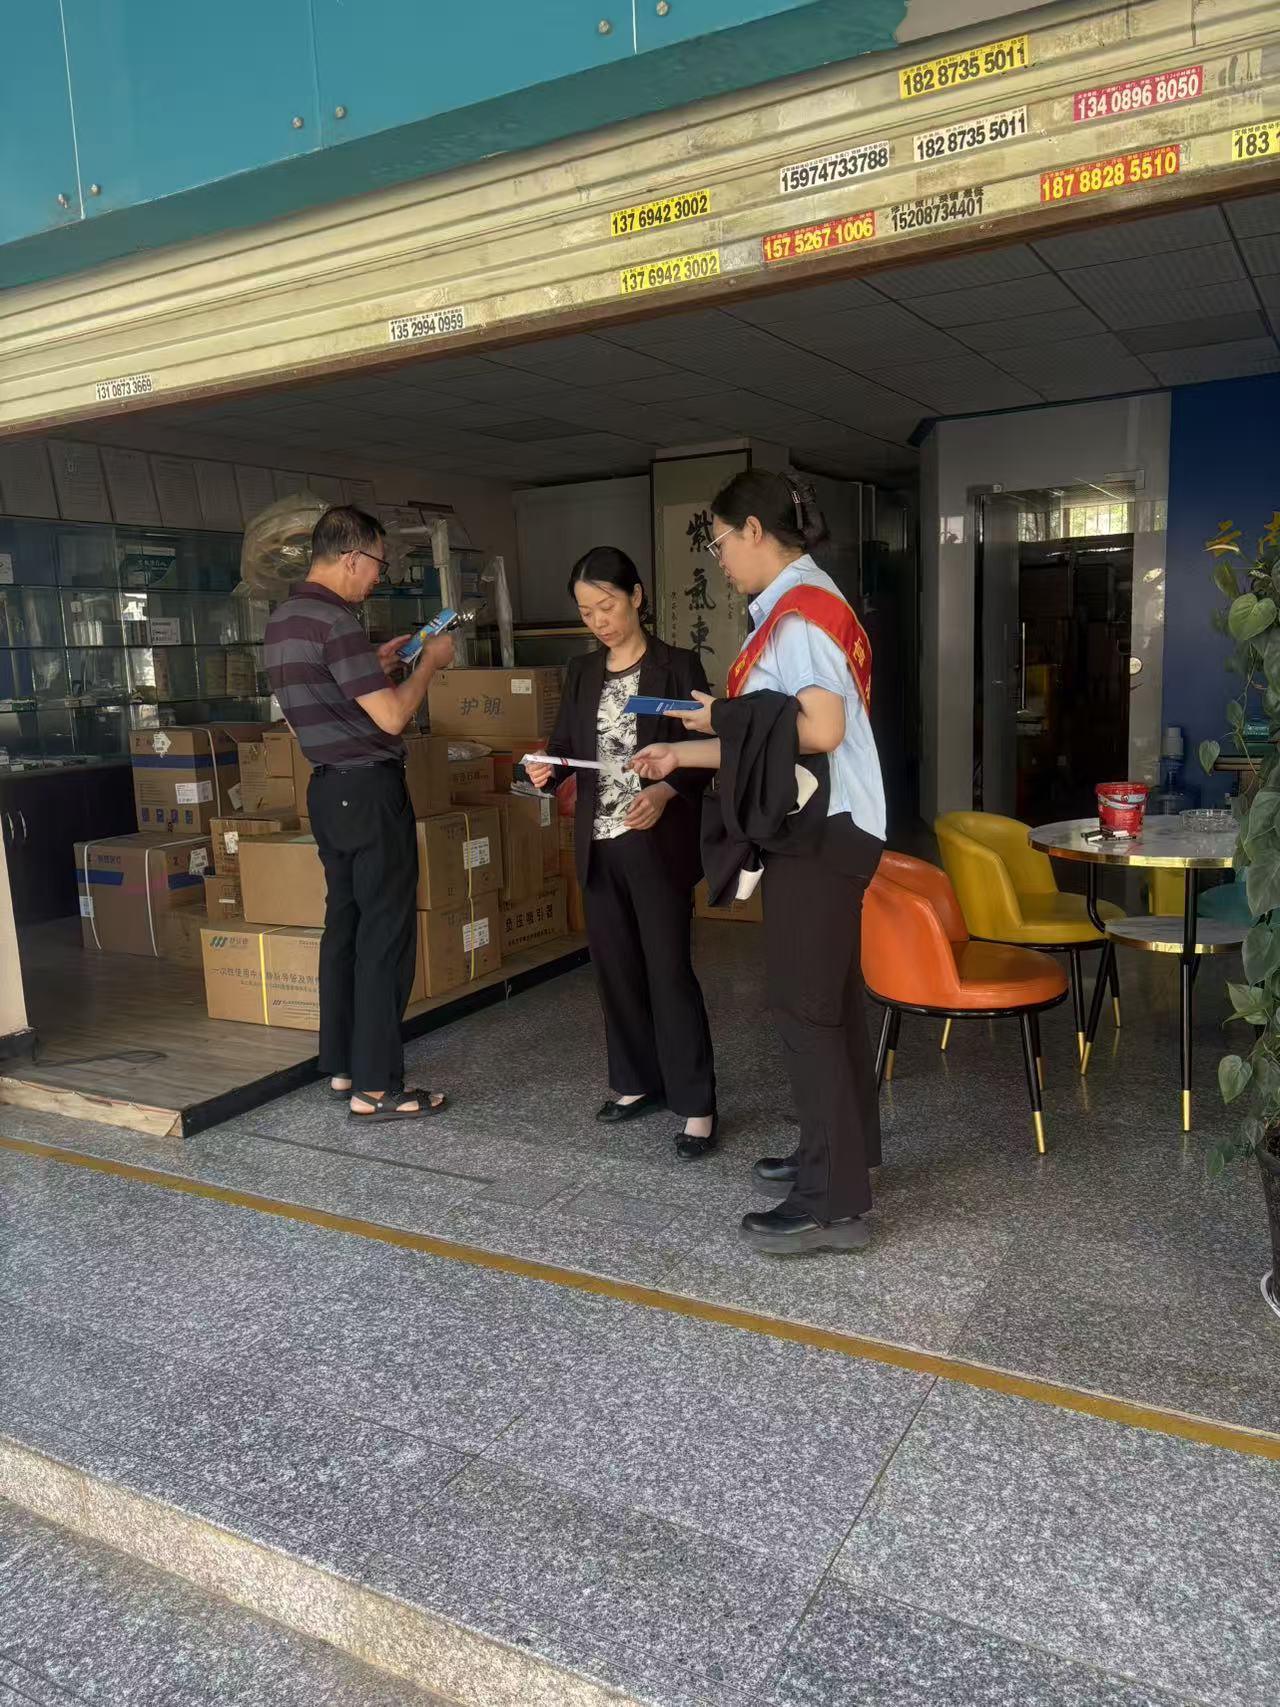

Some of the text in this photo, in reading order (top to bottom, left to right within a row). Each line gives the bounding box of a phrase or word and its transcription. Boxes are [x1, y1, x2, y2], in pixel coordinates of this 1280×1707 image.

[903, 69, 935, 96] 182
[938, 56, 980, 86] 8735
[984, 42, 1025, 73] 5011
[1078, 93, 1107, 119] 134
[1111, 84, 1152, 112] 0896
[1156, 74, 1199, 103] 8050
[917, 136, 945, 160] 182
[947, 124, 985, 152] 8735
[989, 112, 1025, 141] 5011
[1234, 131, 1270, 158] 183
[781, 147, 889, 192] 15974733788
[1042, 173, 1075, 201] 187
[1079, 162, 1125, 193] 8828
[1129, 151, 1177, 182] 5510
[612, 212, 635, 234] 137
[638, 203, 671, 228] 6942
[674, 194, 708, 219] 3002
[891, 196, 983, 232] 15208734401
[764, 236, 791, 260] 157
[794, 227, 831, 253] 5267
[836, 217, 873, 244] 1006
[622, 271, 645, 293] 137
[648, 263, 681, 287] 6942
[684, 255, 717, 280] 3002
[391, 323, 409, 341] 135
[411, 318, 436, 337] 2994
[438, 313, 463, 332] 0959
[96, 386, 110, 400] 131
[112, 382, 131, 397] 0873
[132, 378, 152, 393] 3669
[684, 509, 719, 690] 紫氣東
